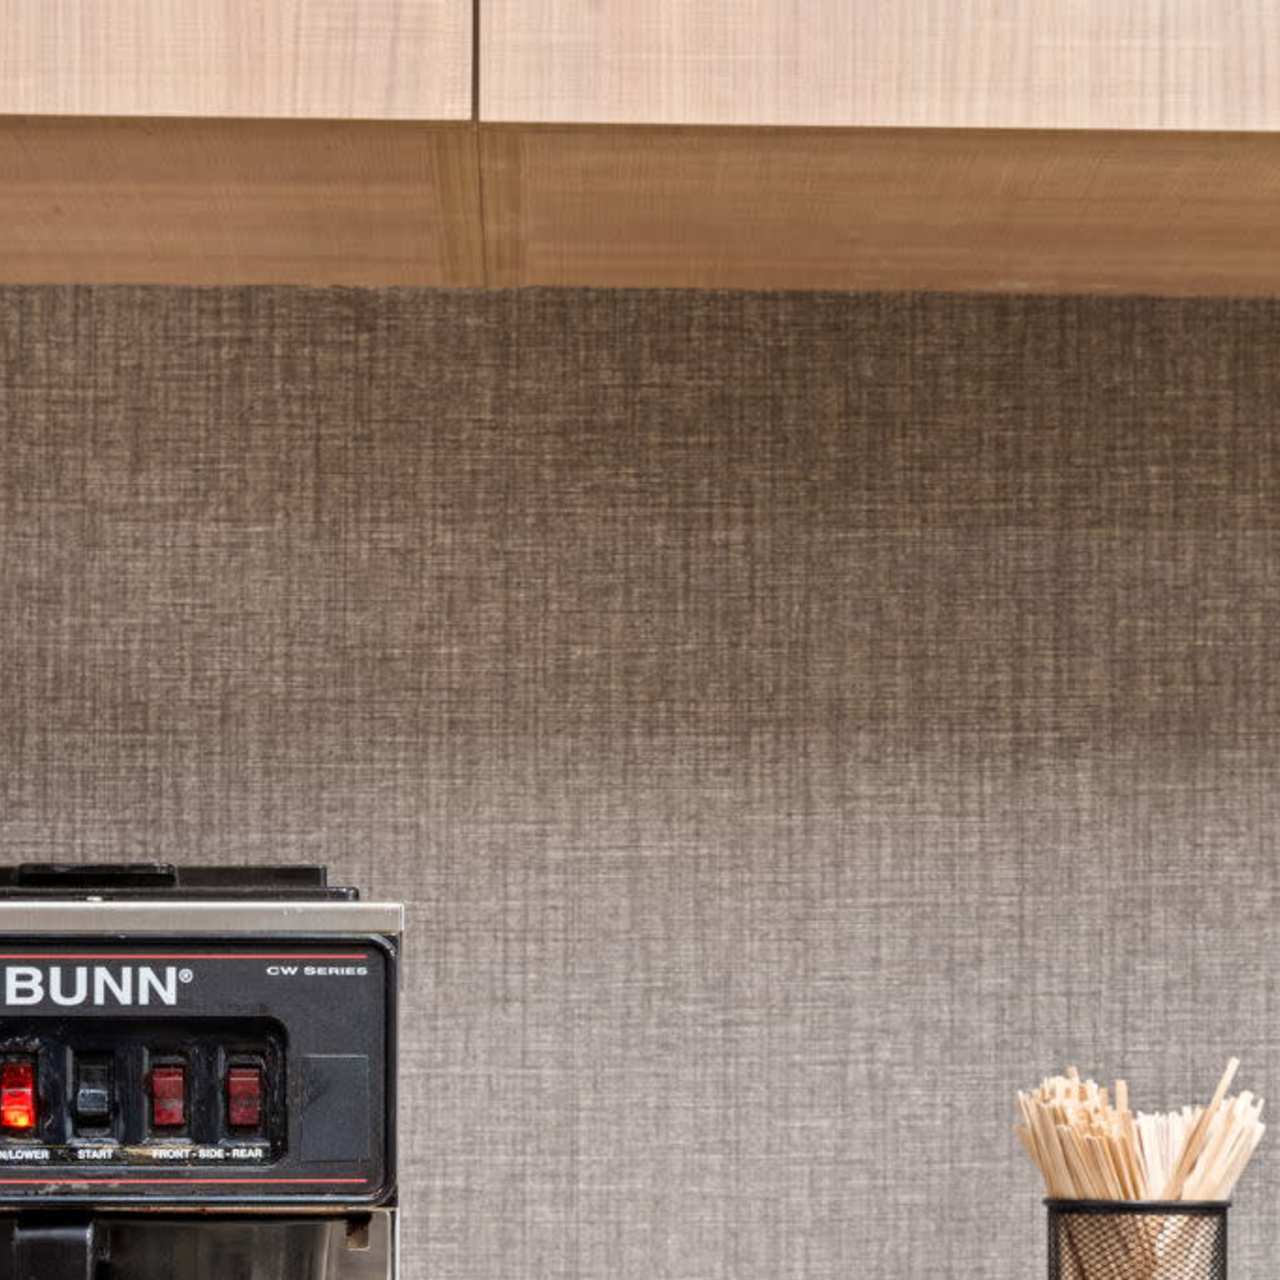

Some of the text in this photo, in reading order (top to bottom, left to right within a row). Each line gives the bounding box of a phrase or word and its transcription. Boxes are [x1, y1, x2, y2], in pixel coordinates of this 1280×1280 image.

[266, 966, 369, 976] CW SERIES
[76, 1149, 114, 1160] START
[151, 1149, 190, 1160] FRONT
[199, 1149, 224, 1160] SIDE
[232, 1148, 263, 1159] REAR
